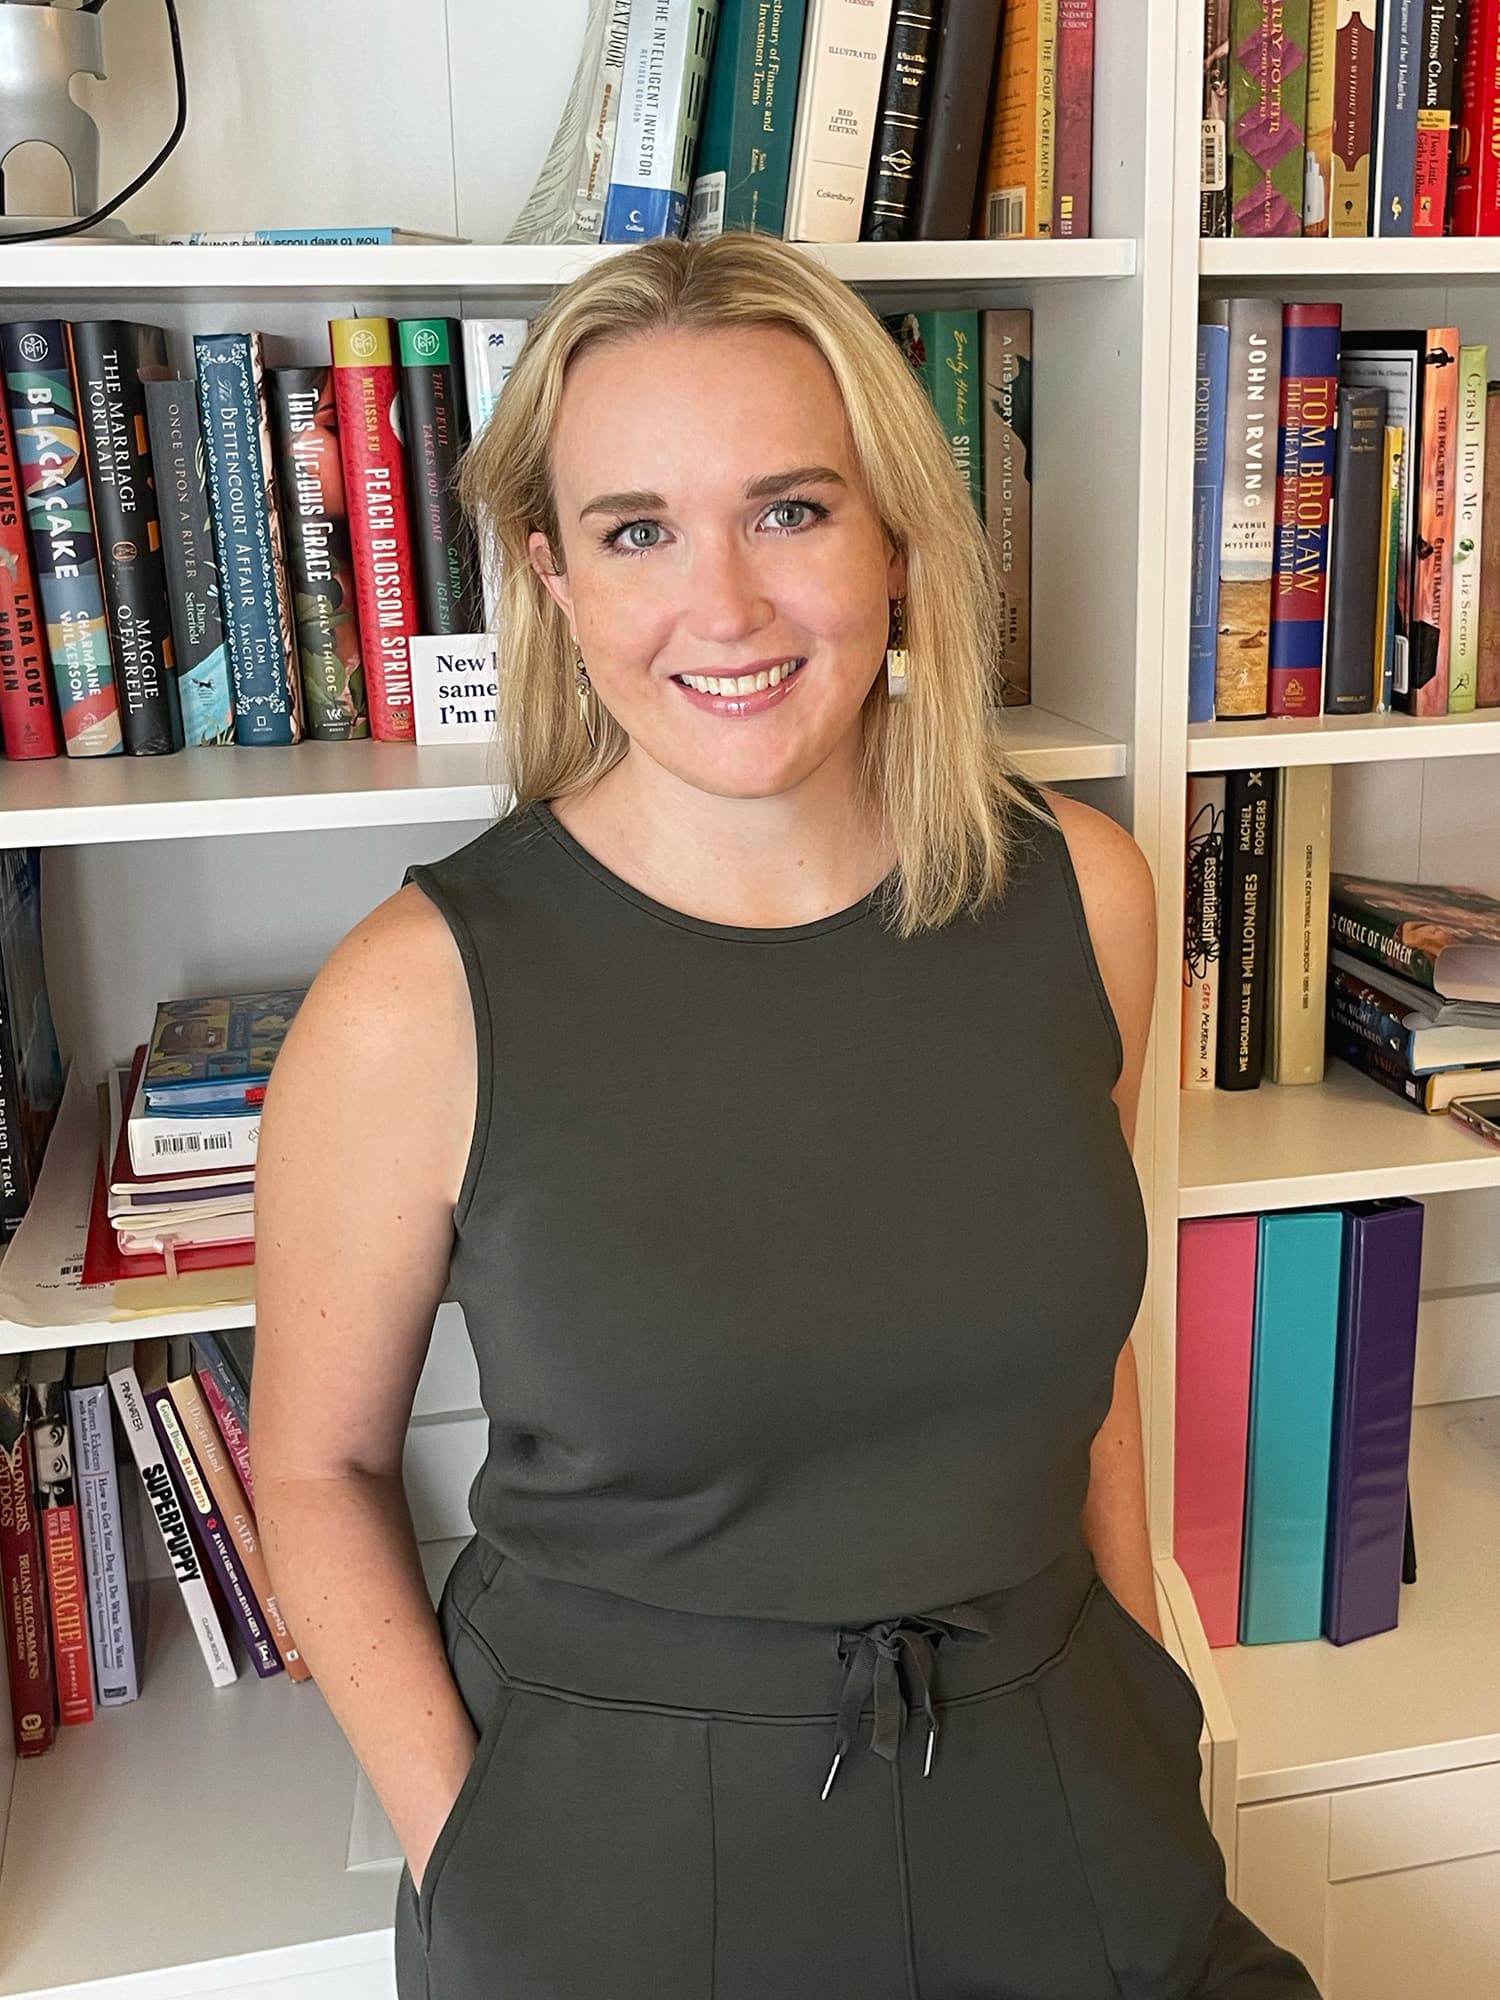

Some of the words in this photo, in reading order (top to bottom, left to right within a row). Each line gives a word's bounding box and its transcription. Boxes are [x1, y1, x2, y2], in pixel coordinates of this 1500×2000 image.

[655, 0, 671, 24] THE
[1429, 6, 1445, 59] HIGGINS
[605, 31, 629, 68] DOOR
[755, 3, 769, 66] Investment
[770, 49, 780, 61] of
[828, 46, 878, 61] ILLUSTRATED
[1044, 38, 1053, 62] THE
[1400, 47, 1408, 62] the
[645, 27, 666, 109] INTELLIGENT
[752, 71, 765, 106] Terms
[764, 64, 779, 108] Finance
[1042, 67, 1052, 104] FOUR
[1427, 60, 1442, 106] CLARK
[838, 109, 853, 117] RED
[1269, 56, 1283, 134] POTTER
[763, 111, 775, 132] and
[828, 125, 858, 136] EDITION
[830, 116, 858, 128] LETTER
[638, 113, 657, 177] INVESTOR
[1040, 108, 1051, 191] AGREEMENTS
[1432, 132, 1441, 154] Two
[1428, 157, 1440, 186] Little
[816, 188, 855, 205] Cokesbury
[1002, 335, 1013, 346] A
[103, 350, 122, 393] THE
[432, 371, 445, 397] THE
[1247, 333, 1267, 400] JOHN
[288, 388, 319, 433] THIS
[361, 378, 379, 432] MELISSA
[1002, 354, 1013, 428] HISTORY
[1287, 382, 1301, 412] THE
[1465, 372, 1483, 432] Crash
[89, 380, 115, 485] PORTRAIT
[168, 404, 184, 449] ONCE
[434, 406, 449, 446] DEVIL
[1300, 381, 1328, 447] TOM
[1438, 406, 1447, 432] THE
[28, 388, 67, 490] BLACK
[109, 402, 136, 512] MARRIAGE
[367, 435, 381, 452] FU
[422, 424, 436, 466] TAKES
[1002, 434, 1010, 450] OF
[1244, 413, 1265, 507] IRVING
[1284, 416, 1300, 492] GREATEST
[174, 458, 190, 503] UPON
[290, 438, 325, 515] VICIOUS
[427, 470, 439, 497] YOU
[952, 435, 971, 491] SHAR
[1002, 456, 1013, 500] WILD
[1464, 443, 1479, 484] Into
[180, 511, 190, 521] A
[220, 407, 248, 535] BETTENCOURT
[236, 545, 255, 608] AFFAIR
[364, 468, 395, 530] PEACH
[1435, 479, 1445, 518] RULES
[1461, 493, 1478, 521] Me
[45, 496, 79, 579] CAKE
[430, 503, 443, 543] HOME
[1002, 507, 1012, 573] PLACES
[1294, 461, 1325, 594] BROKAW
[181, 530, 197, 578] RIVER
[301, 521, 334, 583] GRACE
[1279, 500, 1296, 595] GENERATION
[371, 539, 404, 628] BLOSSOM
[447, 547, 462, 599] GABINO
[1461, 574, 1473, 594] Liz
[196, 603, 206, 634] Diane
[316, 594, 330, 636] EMILY
[1009, 607, 1017, 643] SHEA
[1459, 600, 1472, 656] Seccuro
[14, 594, 33, 646] LARA
[24, 657, 44, 706] LOVE
[60, 611, 84, 701] WILKERSON
[77, 611, 101, 695] CHARMAINE
[136, 619, 159, 699] MAGGIE
[240, 623, 255, 680] SANCTON
[255, 638, 266, 665] TOM
[380, 636, 412, 706] SPRING
[436, 655, 485, 673] New
[439, 683, 498, 699] same
[1240, 804, 1252, 851] RACHEL
[1254, 800, 1267, 855] RODGERS
[1201, 856, 1218, 942] essentialism
[1241, 873, 1258, 978] MILLIONAIRES
[1337, 913, 1368, 944] CIRCLE
[1367, 932, 1380, 950] OF
[1380, 935, 1413, 965] WOMEN
[1241, 997, 1251, 1014] ALL
[1239, 1016, 1250, 1055] SHOULD
[1239, 1056, 1248, 1072] WE
[1, 1155, 16, 1198] Track
[86, 1395, 97, 1432] Warren
[120, 1381, 143, 1431] PINKWATER
[222, 1411, 242, 1446] Shelby
[89, 1432, 101, 1472] Eckstein
[0, 1483, 15, 1527] DOGS
[13, 1467, 32, 1535] OWNERS,
[98, 1478, 109, 1502] How
[101, 1503, 107, 1511] to
[101, 1512, 112, 1528] Get
[103, 1529, 113, 1552] Your
[142, 1463, 200, 1584] SUPERPUPPY
[234, 1515, 257, 1552] GATES
[19, 1554, 33, 1594] BRIAN
[105, 1553, 116, 1575] Dog
[108, 1574, 114, 1583] to
[51, 1536, 82, 1644] HEADACHE
[109, 1583, 119, 1600] Do
[110, 1600, 122, 1624] What
[113, 1625, 123, 1643] You
[114, 1644, 124, 1669] Want
